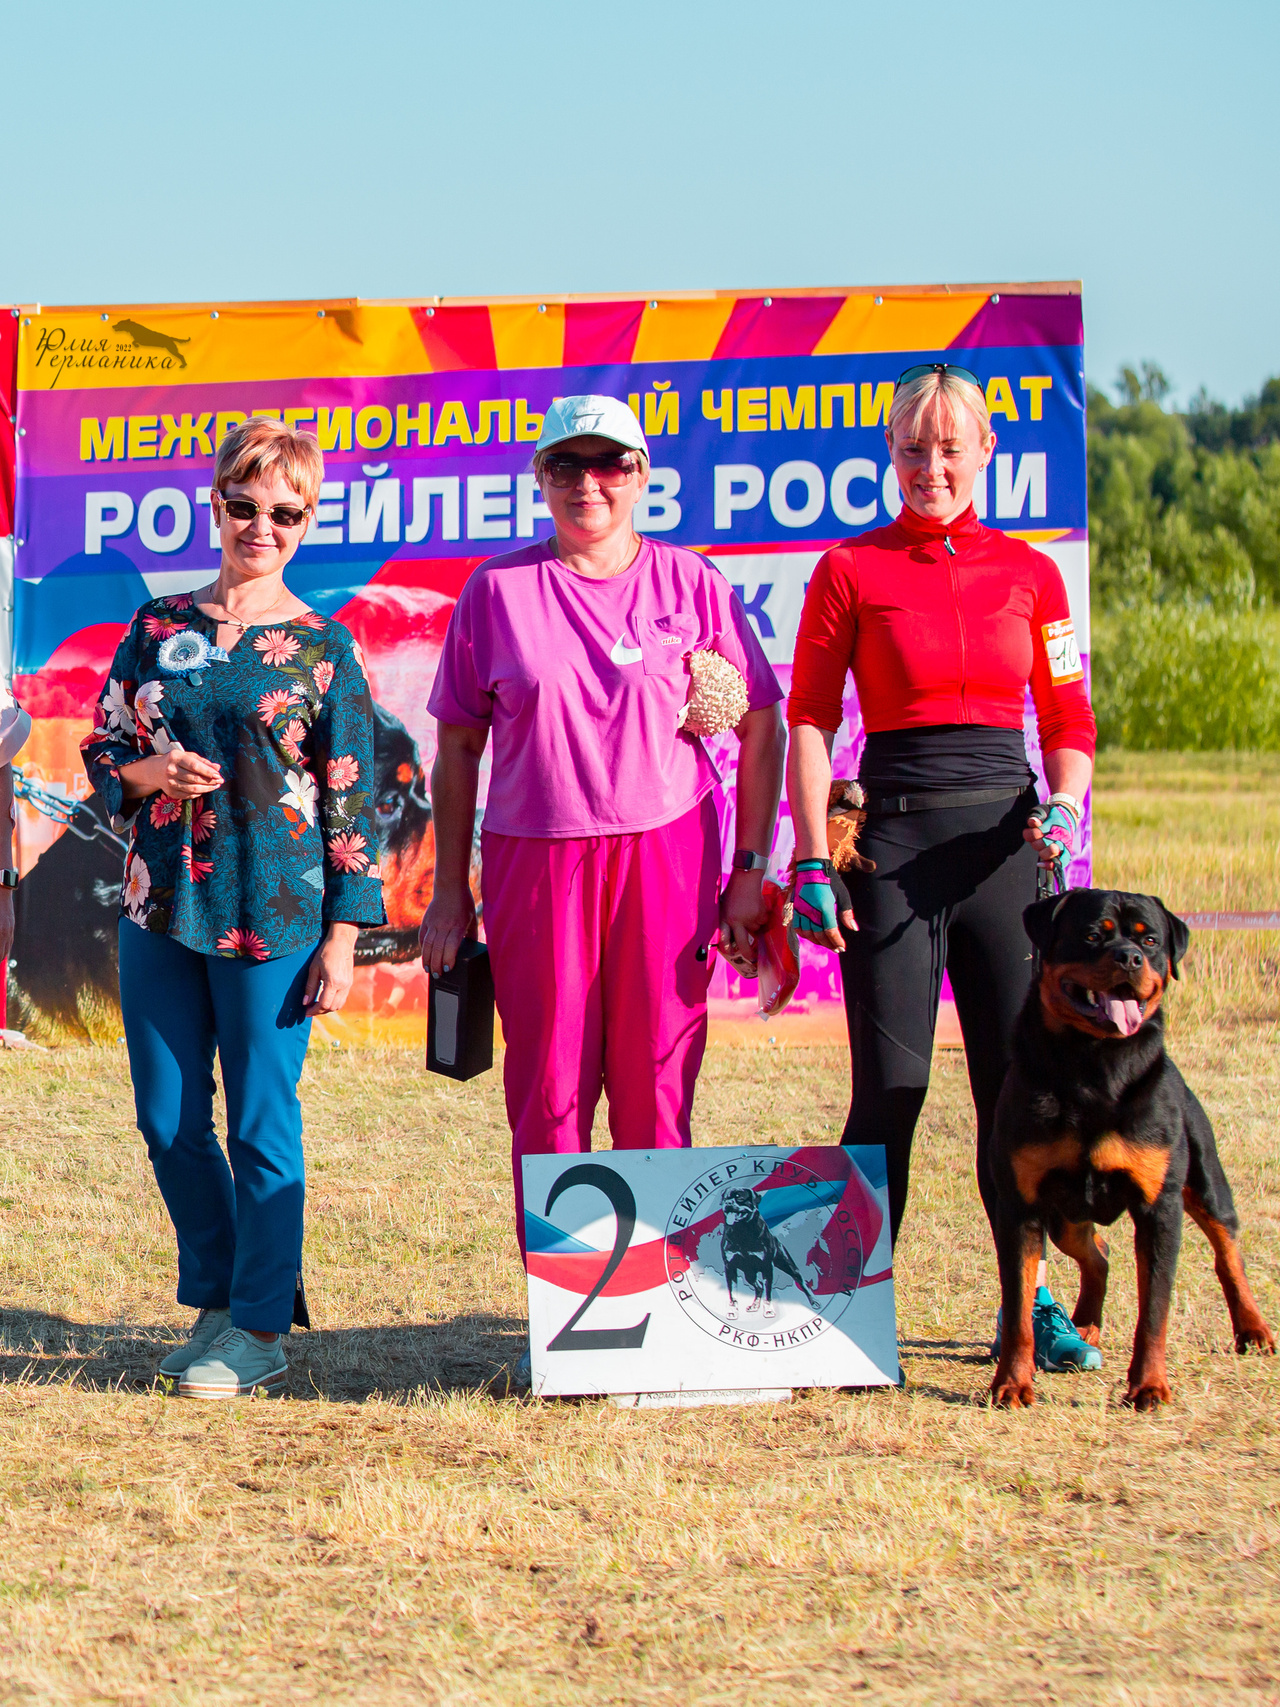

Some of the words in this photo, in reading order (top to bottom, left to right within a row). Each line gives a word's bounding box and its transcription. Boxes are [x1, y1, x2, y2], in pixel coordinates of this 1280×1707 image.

[35, 343, 177, 390] Германика
[36, 327, 112, 352] Юлия
[115, 343, 132, 352] 2022
[702, 376, 1053, 434] ЧЕМПИАТ
[714, 451, 1048, 530] РОСИ
[543, 1162, 652, 1352] 2
[667, 1163, 739, 1302] РОТВЕЙЛЕР
[753, 1159, 820, 1189] КЛУБ
[825, 1193, 861, 1298] РОССИИ
[718, 1316, 824, 1349] РКФ-НКПР
